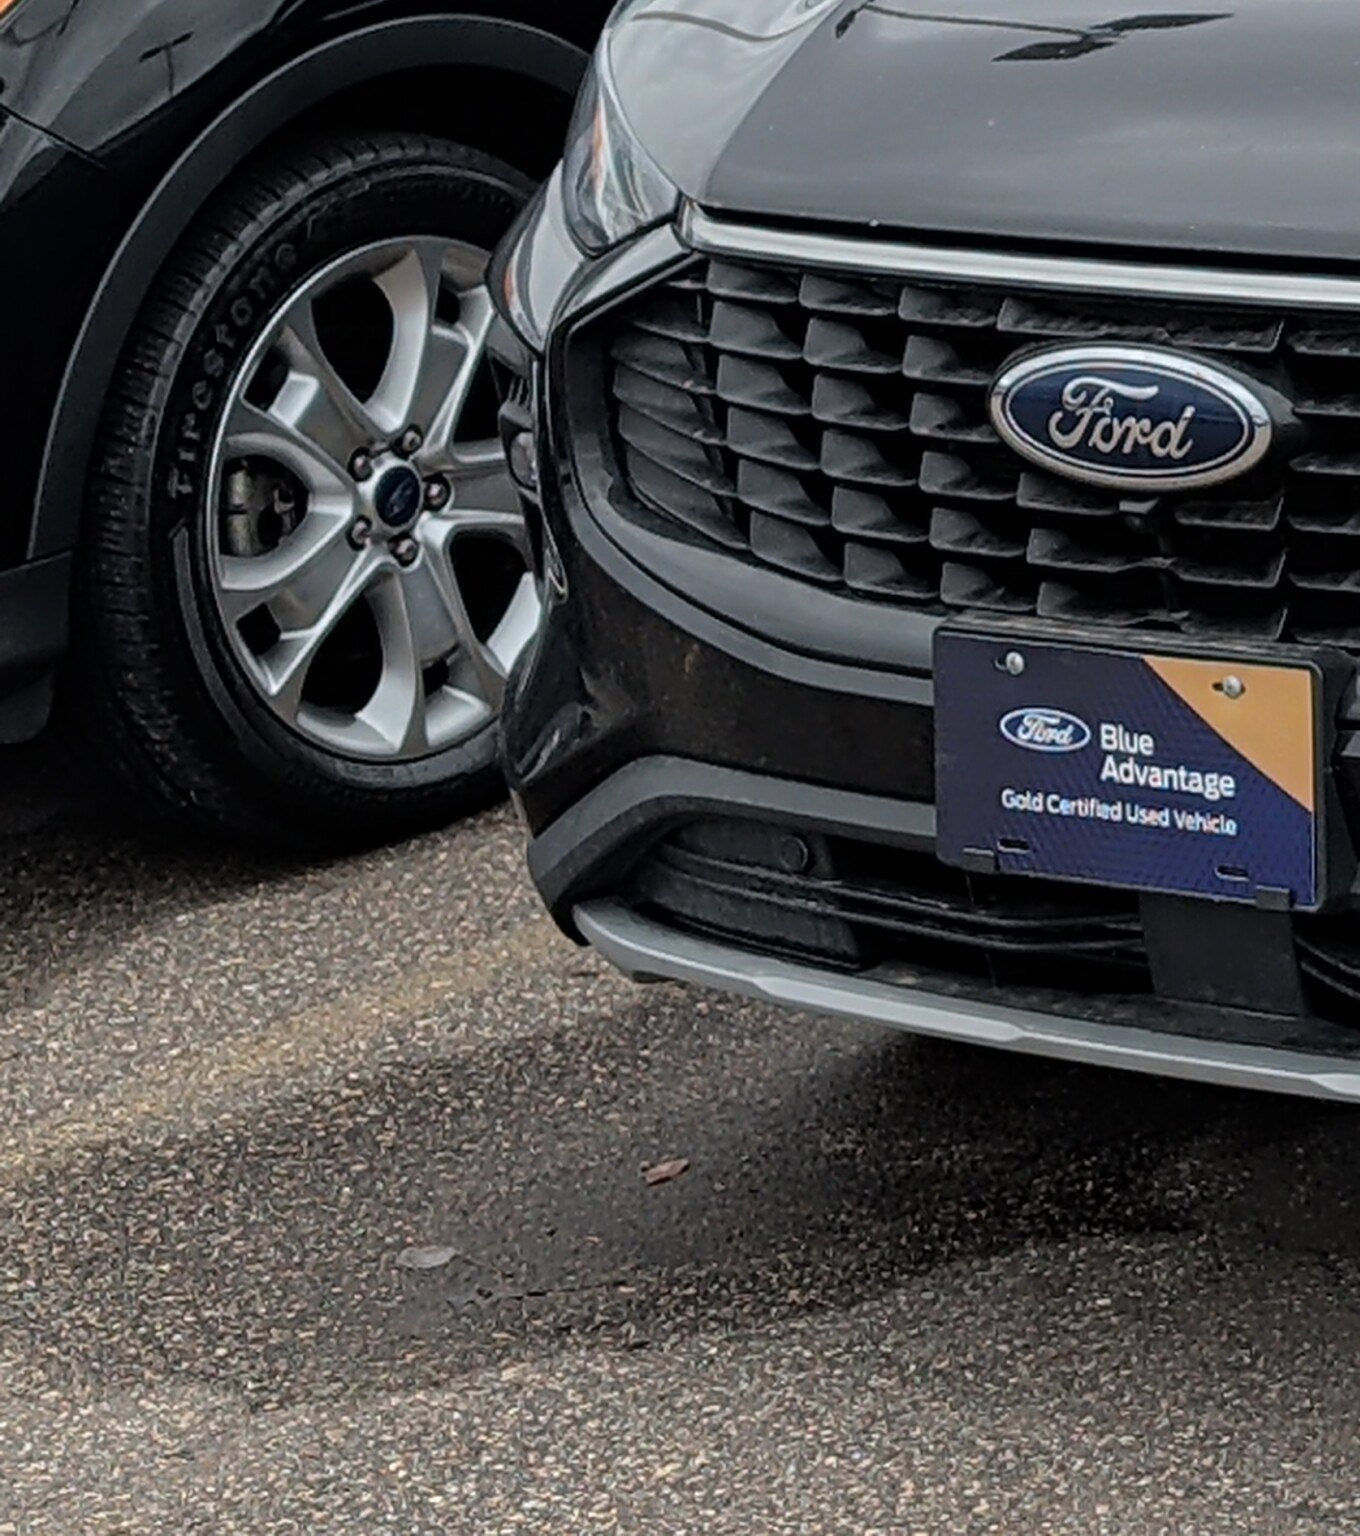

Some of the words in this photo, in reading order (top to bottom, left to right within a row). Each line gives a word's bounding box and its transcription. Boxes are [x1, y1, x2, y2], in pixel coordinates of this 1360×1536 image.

[1049, 376, 1196, 460] Ford
[1015, 711, 1075, 746] Ford
[1100, 722, 1155, 757] Blue
[1100, 756, 1236, 801] Advantage
[1001, 788, 1045, 814] Gold
[1046, 793, 1122, 822] Certified
[1125, 803, 1170, 829] Used
[1173, 809, 1238, 837] Vehicle
